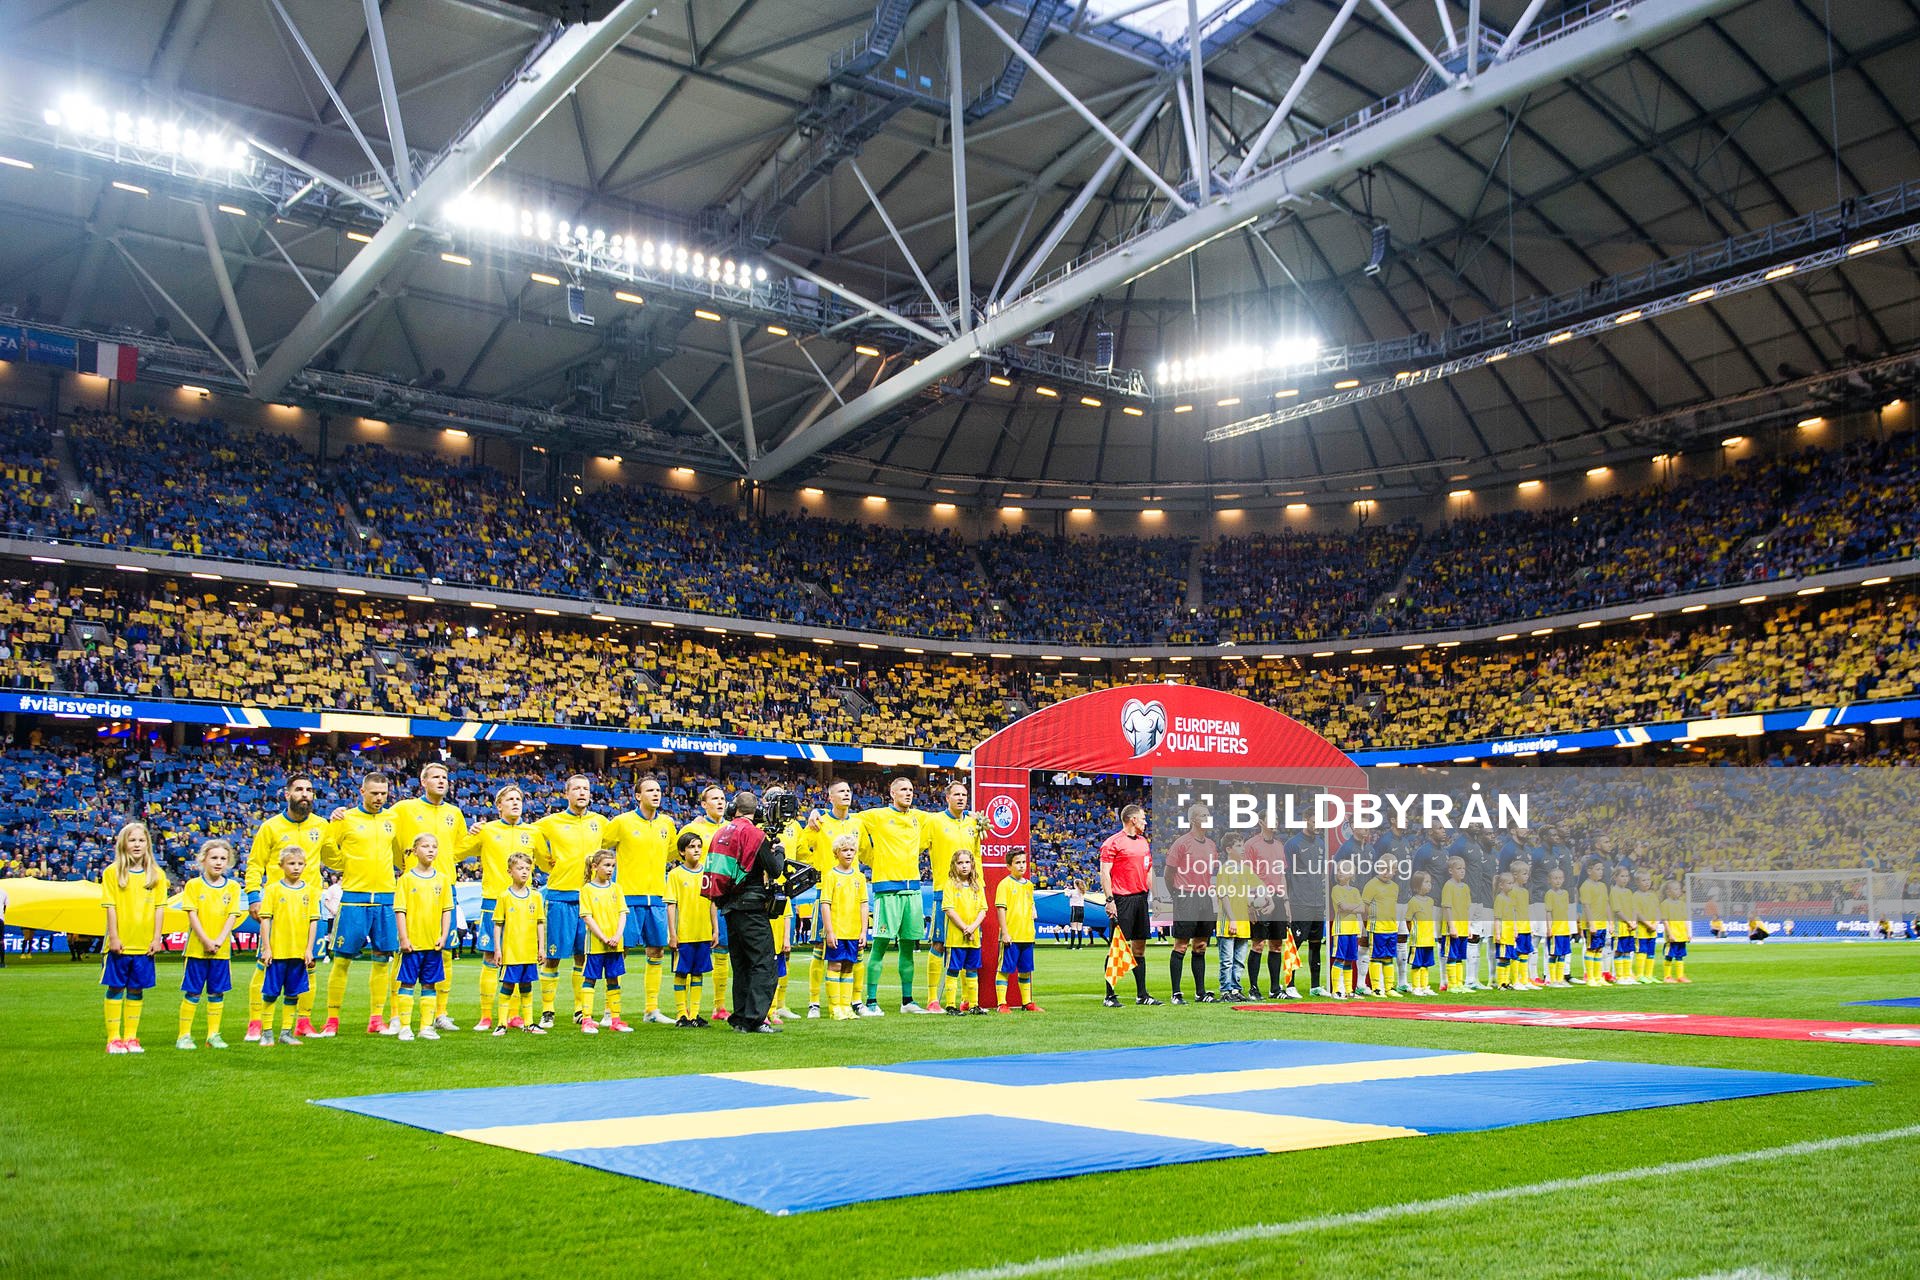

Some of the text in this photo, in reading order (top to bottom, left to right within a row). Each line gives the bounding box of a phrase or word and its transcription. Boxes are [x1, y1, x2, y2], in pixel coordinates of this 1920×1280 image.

[19, 696, 133, 718] #viärsverige
[1175, 717, 1240, 736] EUROPEAN
[661, 736, 737, 754] #viärsverige
[1166, 732, 1249, 755] QUALIFIERS
[1491, 738, 1558, 755] #viärsverige
[992, 799, 1013, 808] UEFA
